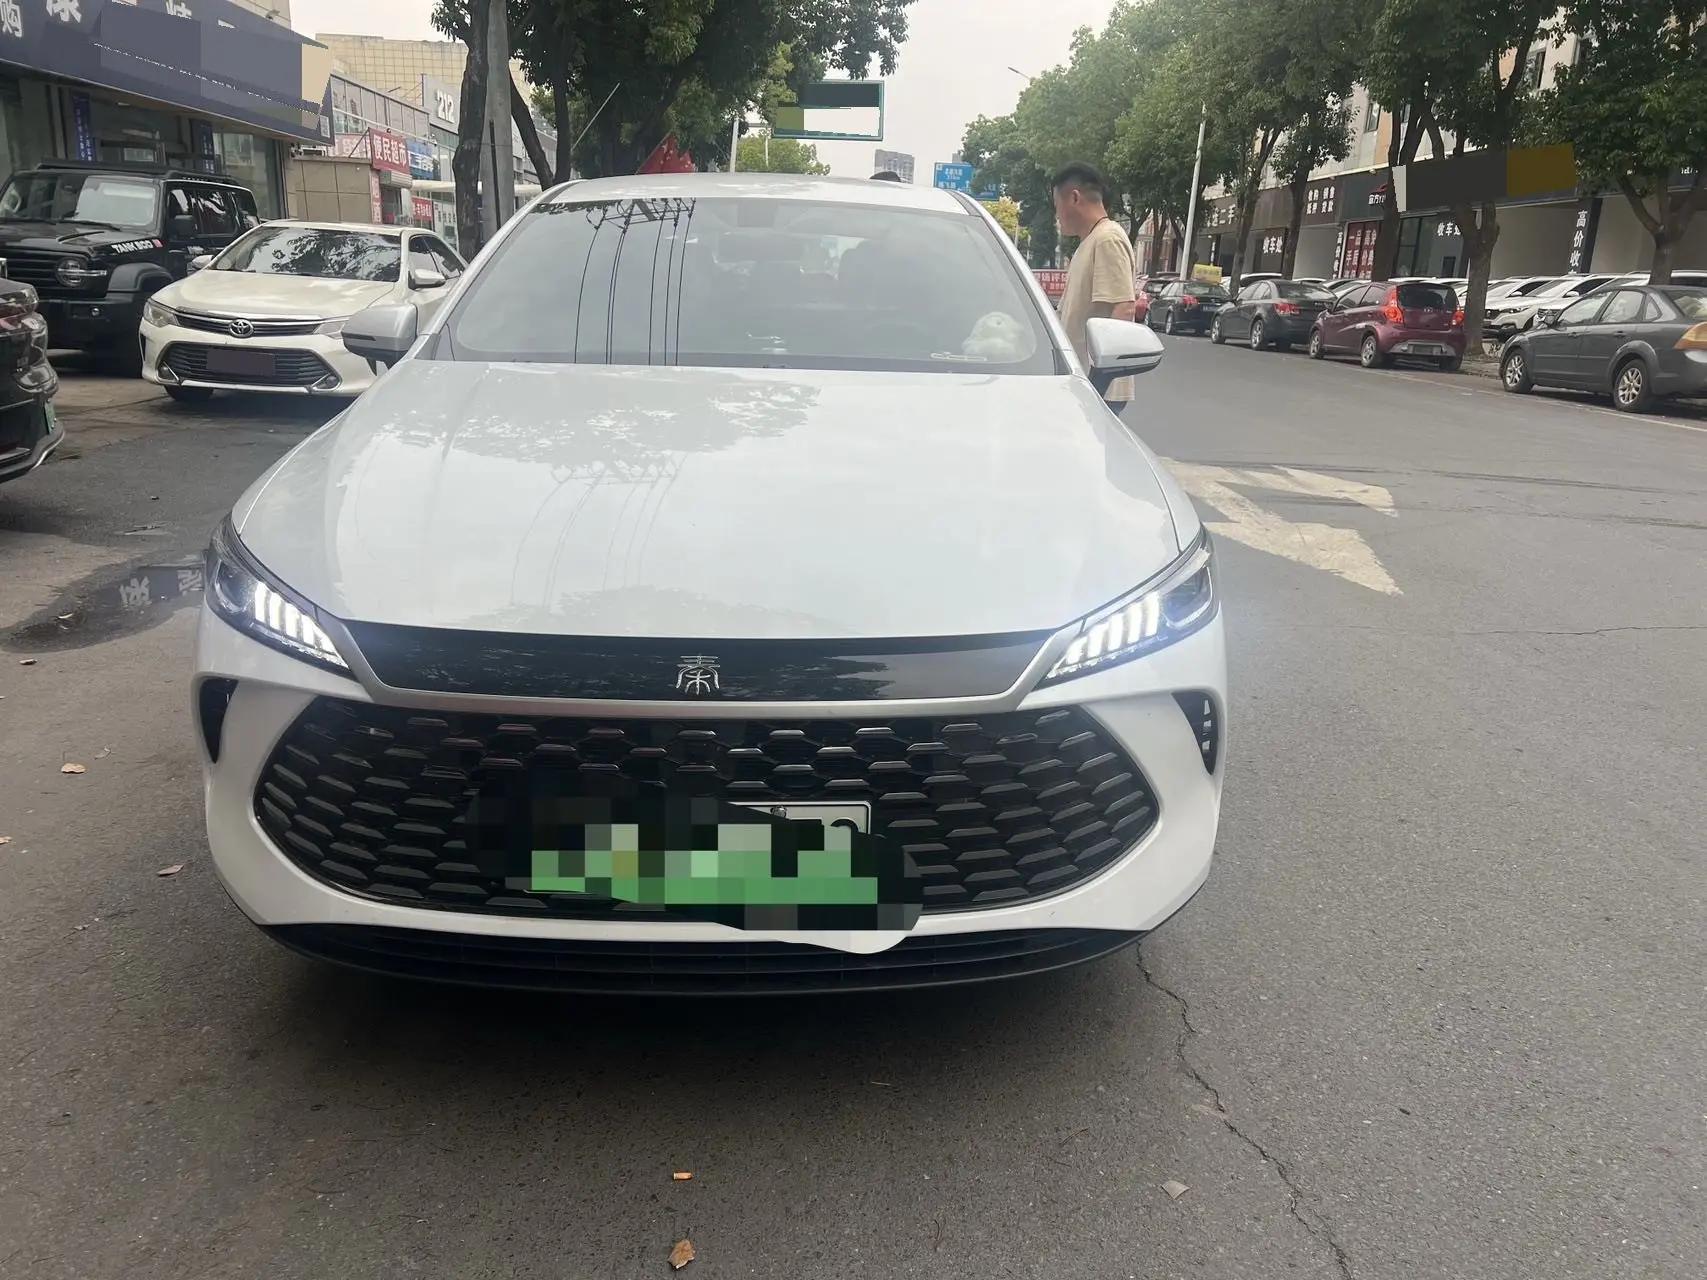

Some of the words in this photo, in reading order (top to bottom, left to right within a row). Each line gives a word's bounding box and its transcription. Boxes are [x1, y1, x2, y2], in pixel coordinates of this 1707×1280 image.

[436, 89, 455, 123] 212
[373, 134, 407, 167] 便民超市
[111, 241, 138, 254] TANK
[1568, 209, 1588, 274] 高价收
